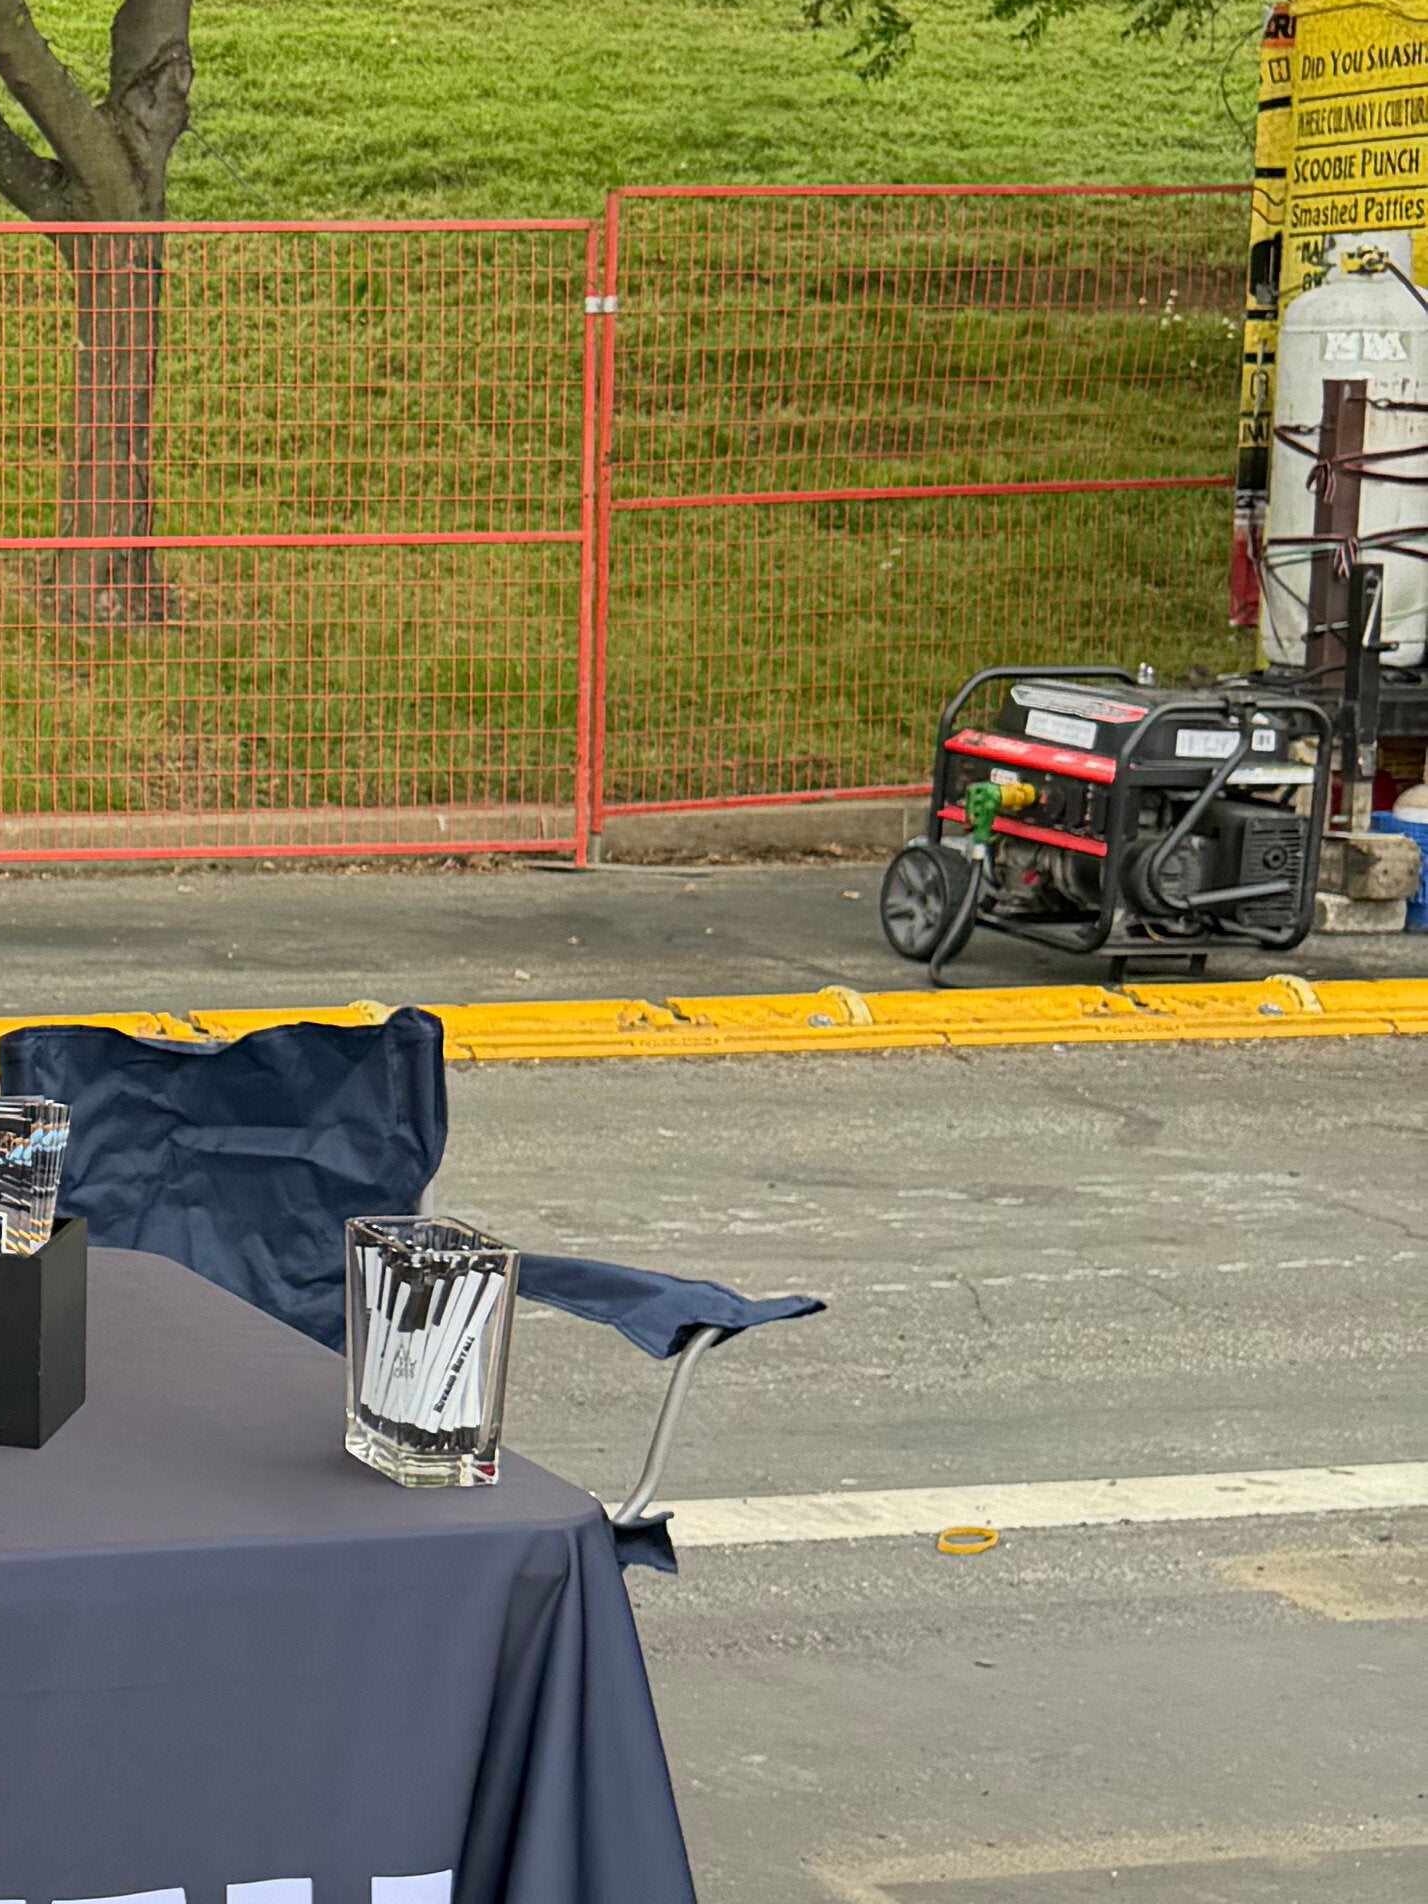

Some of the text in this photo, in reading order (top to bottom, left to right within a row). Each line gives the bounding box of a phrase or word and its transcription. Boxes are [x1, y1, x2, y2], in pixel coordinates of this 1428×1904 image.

[1360, 147, 1420, 179] PUNCH
[1290, 196, 1426, 228] Smashed Patties
